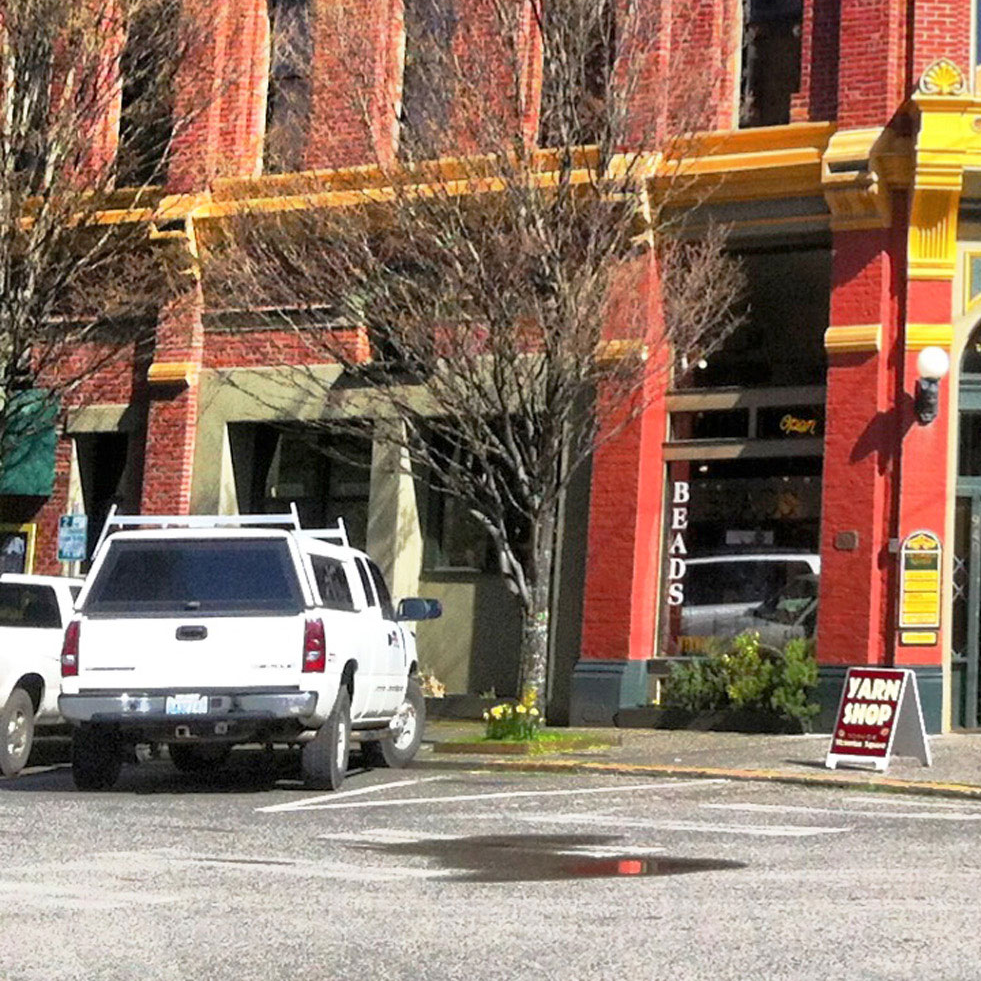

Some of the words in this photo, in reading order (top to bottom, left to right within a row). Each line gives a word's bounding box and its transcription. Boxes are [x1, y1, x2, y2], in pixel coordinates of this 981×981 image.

[667, 481, 690, 606] BEADS
[847, 676, 901, 701] YARN
[842, 702, 892, 726] SHOP
